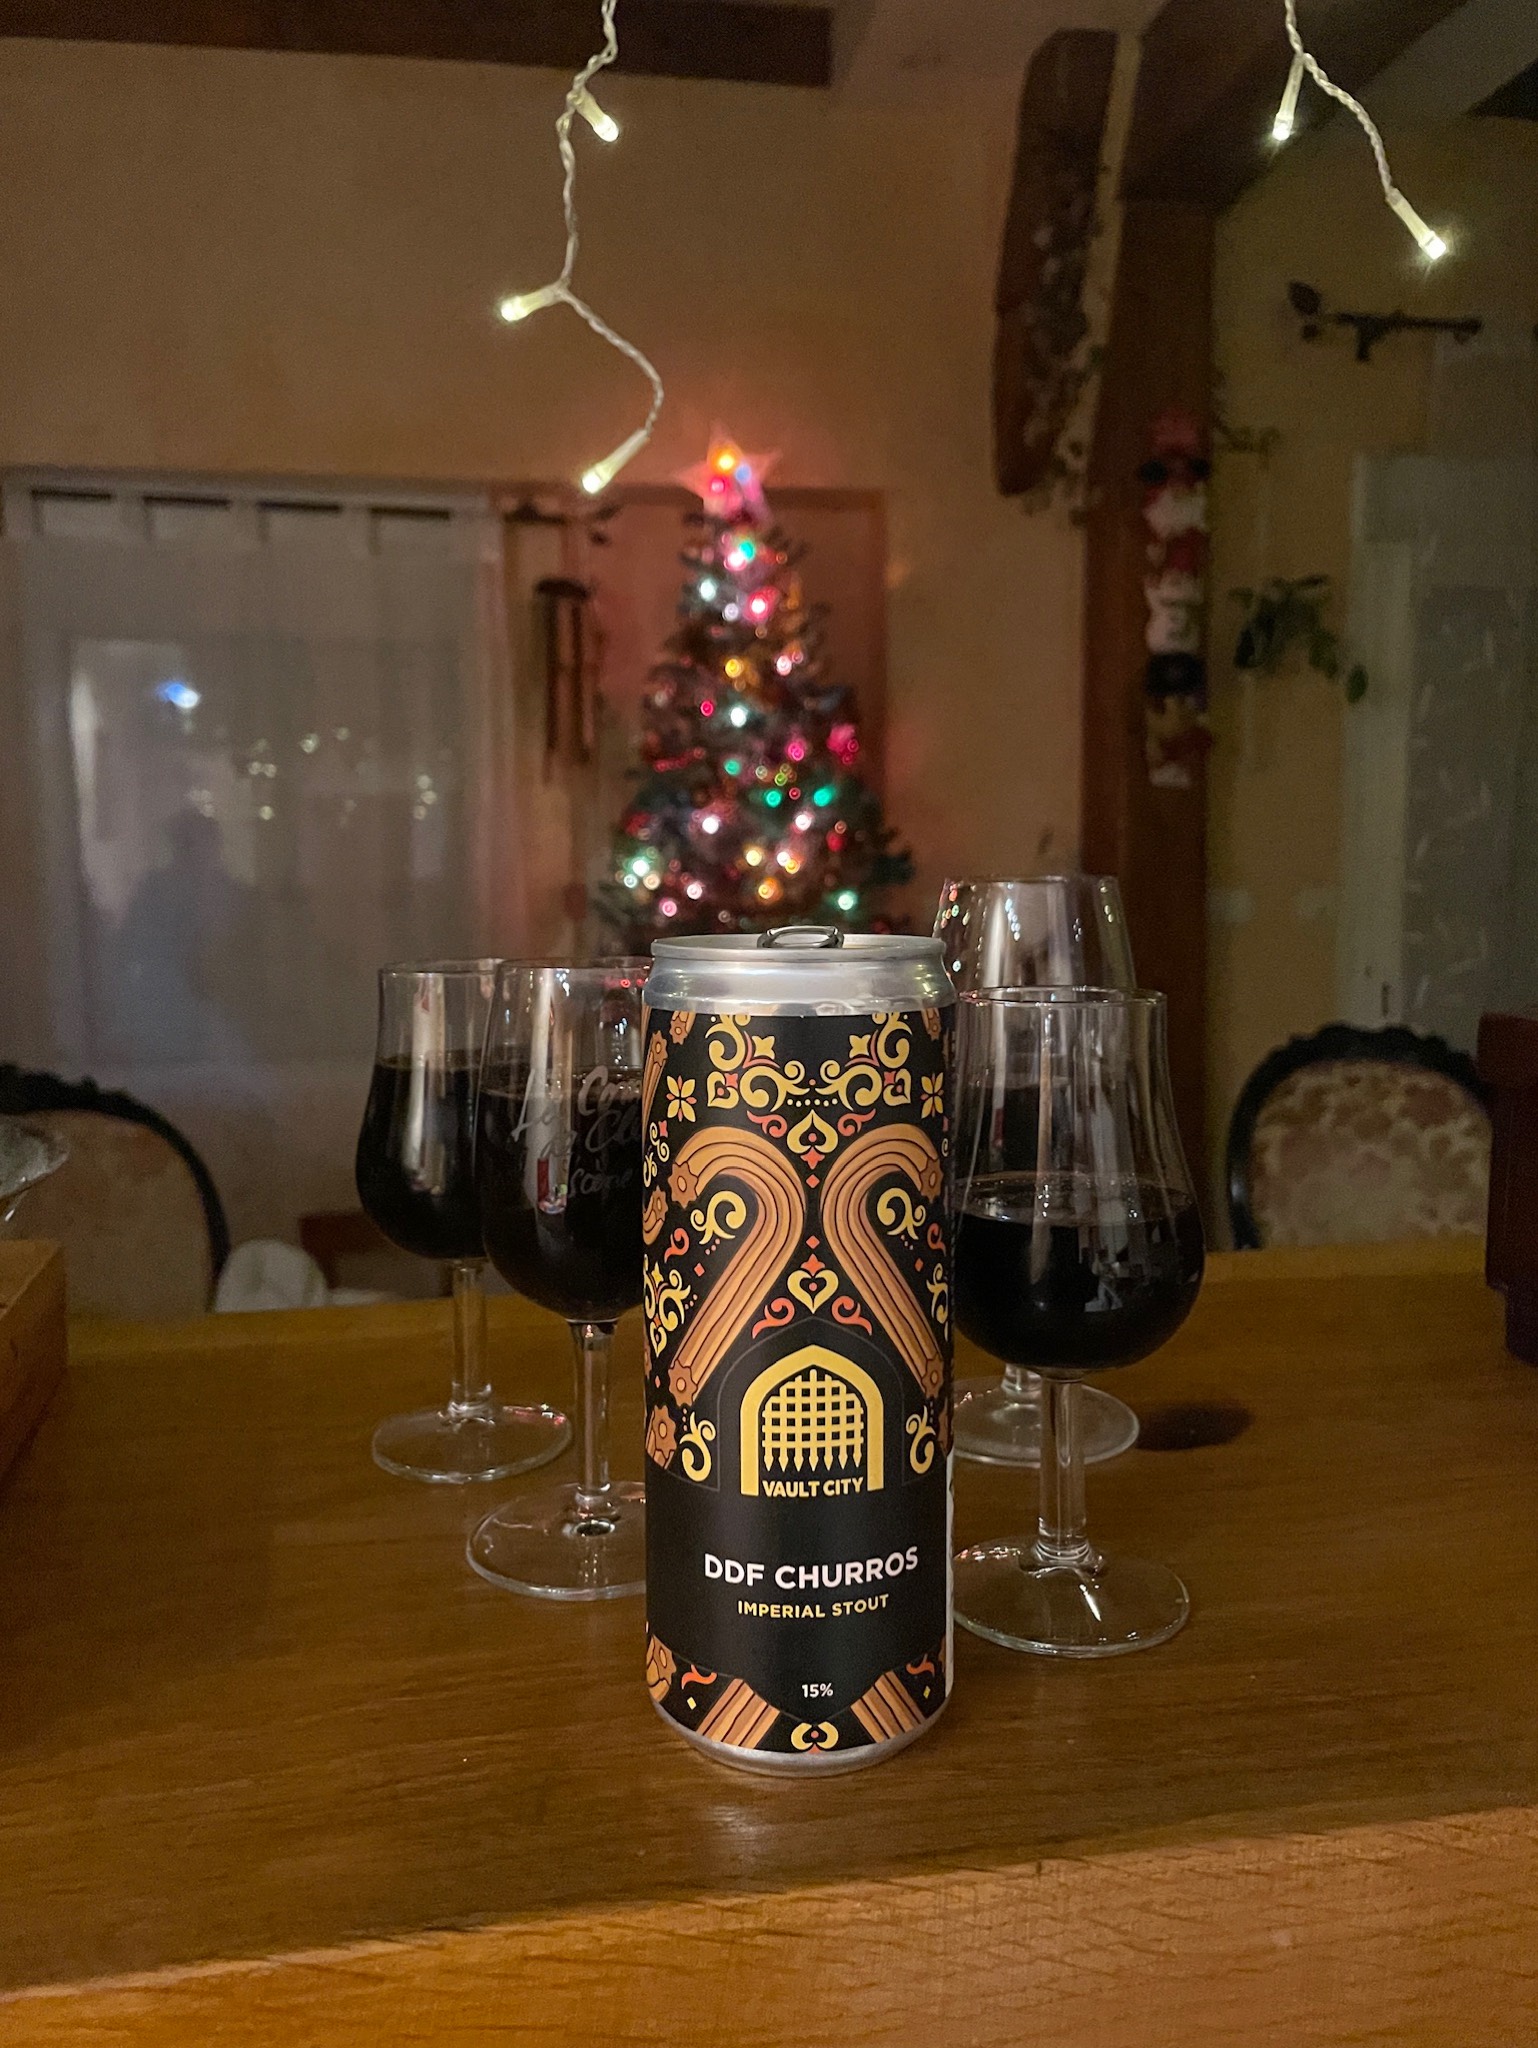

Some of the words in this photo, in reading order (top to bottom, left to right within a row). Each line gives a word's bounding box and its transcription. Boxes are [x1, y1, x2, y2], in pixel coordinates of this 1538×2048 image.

[762, 1480, 820, 1498] VAULT
[822, 1476, 863, 1497] CITY
[704, 1553, 765, 1587] DDF
[774, 1546, 919, 1590] CHURROS
[737, 1600, 826, 1619] IMPERIAL
[831, 1593, 889, 1617] STOUT
[801, 1682, 834, 1699] 15%
